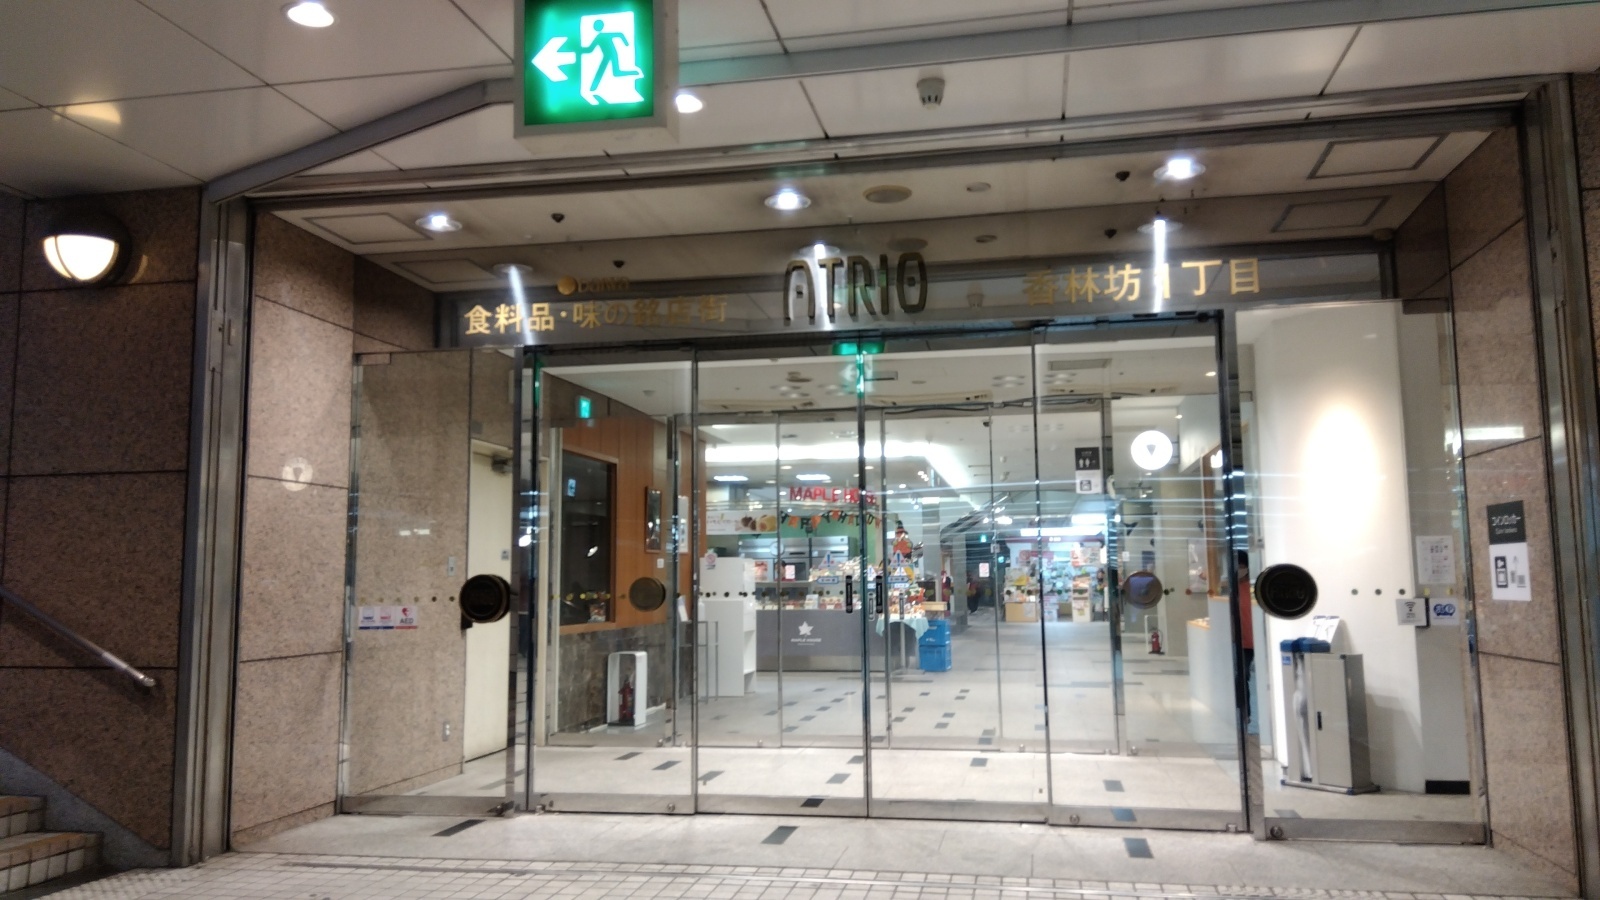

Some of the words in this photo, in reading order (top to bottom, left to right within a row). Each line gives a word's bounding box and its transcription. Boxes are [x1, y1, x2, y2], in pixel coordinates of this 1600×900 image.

[783, 252, 928, 325] ATRIO
[789, 485, 840, 503] MAPLE
[400, 617, 414, 625] AED
